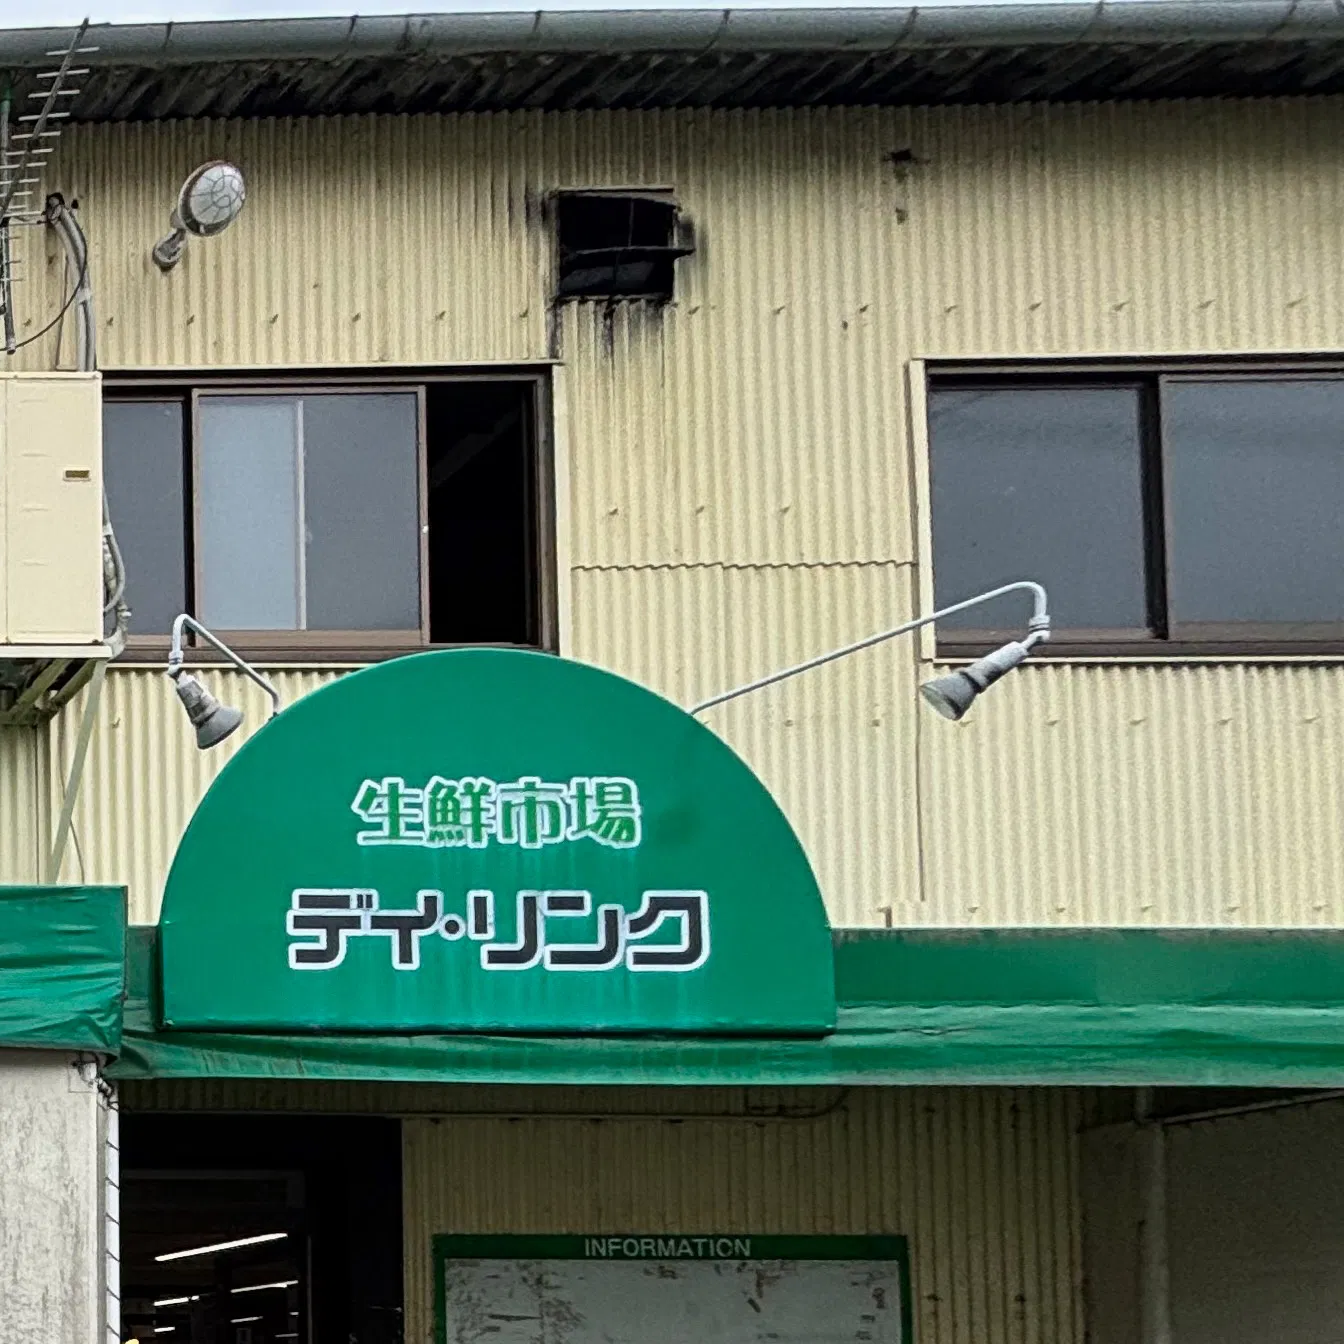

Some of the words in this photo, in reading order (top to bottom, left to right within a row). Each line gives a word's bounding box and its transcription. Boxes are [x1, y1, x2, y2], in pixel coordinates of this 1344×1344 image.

[350, 775, 643, 850] 生鮮市場
[583, 1237, 753, 1258] INFORMATION
